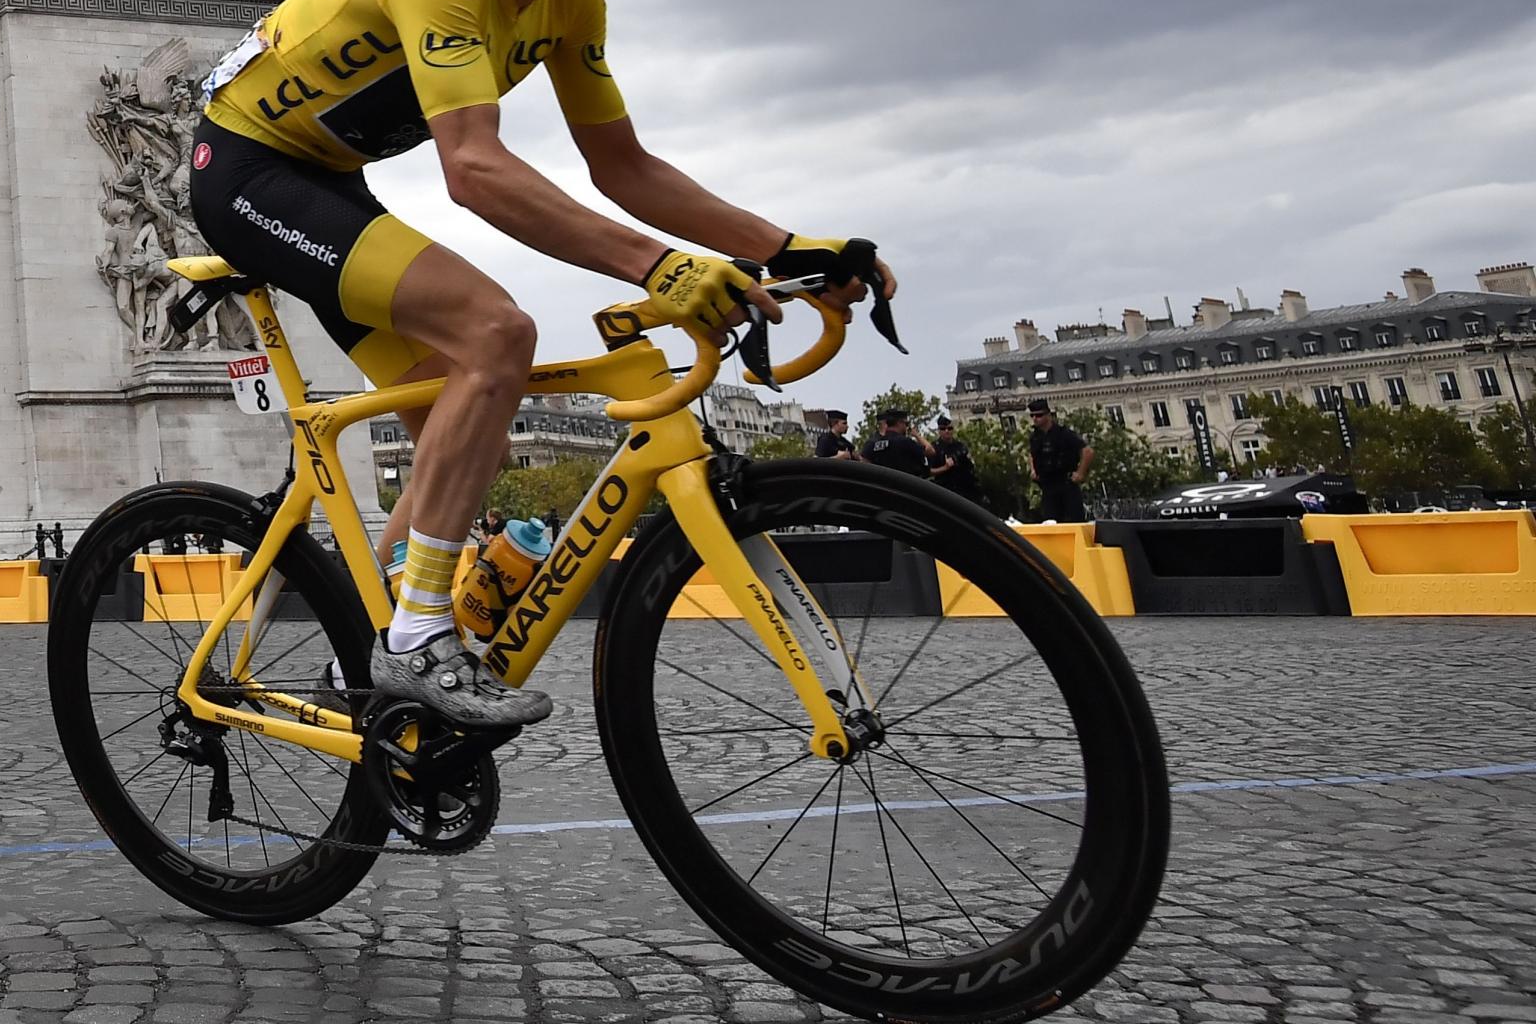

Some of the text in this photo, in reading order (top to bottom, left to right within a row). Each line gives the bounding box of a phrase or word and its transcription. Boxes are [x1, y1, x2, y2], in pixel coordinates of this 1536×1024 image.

[322, 31, 402, 80] LCL
[257, 76, 324, 121] LCL
[231, 195, 339, 267] #PassOnPlastic
[656, 257, 694, 297] sky
[259, 316, 282, 349] sky
[229, 358, 265, 377] Vittel
[254, 378, 271, 412] 8
[1175, 505, 1218, 515] OAKLEY
[747, 583, 806, 672] PINARELLO
[776, 568, 837, 652] PINARELLO
[214, 712, 265, 733] SHIMANO
[772, 878, 1096, 996] DURA-ACE
